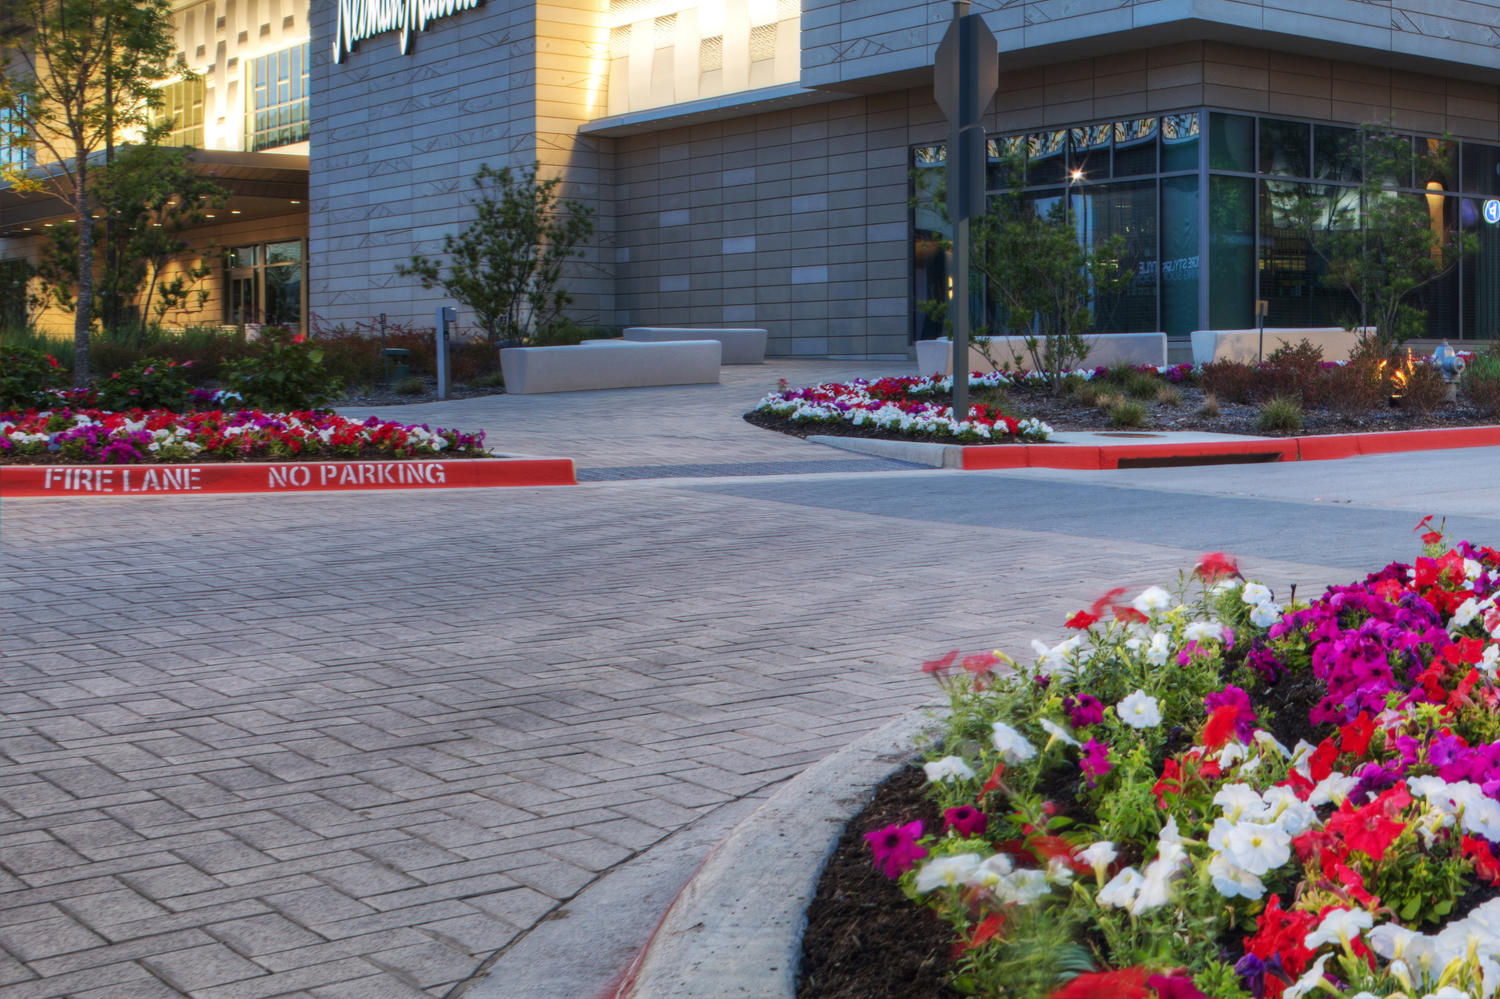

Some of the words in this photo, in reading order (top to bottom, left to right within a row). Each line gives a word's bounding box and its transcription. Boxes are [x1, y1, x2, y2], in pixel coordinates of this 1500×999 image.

[44, 468, 113, 492] FIRE
[123, 468, 202, 492] LANE
[269, 465, 311, 488] NO
[320, 463, 446, 486] PARKING
